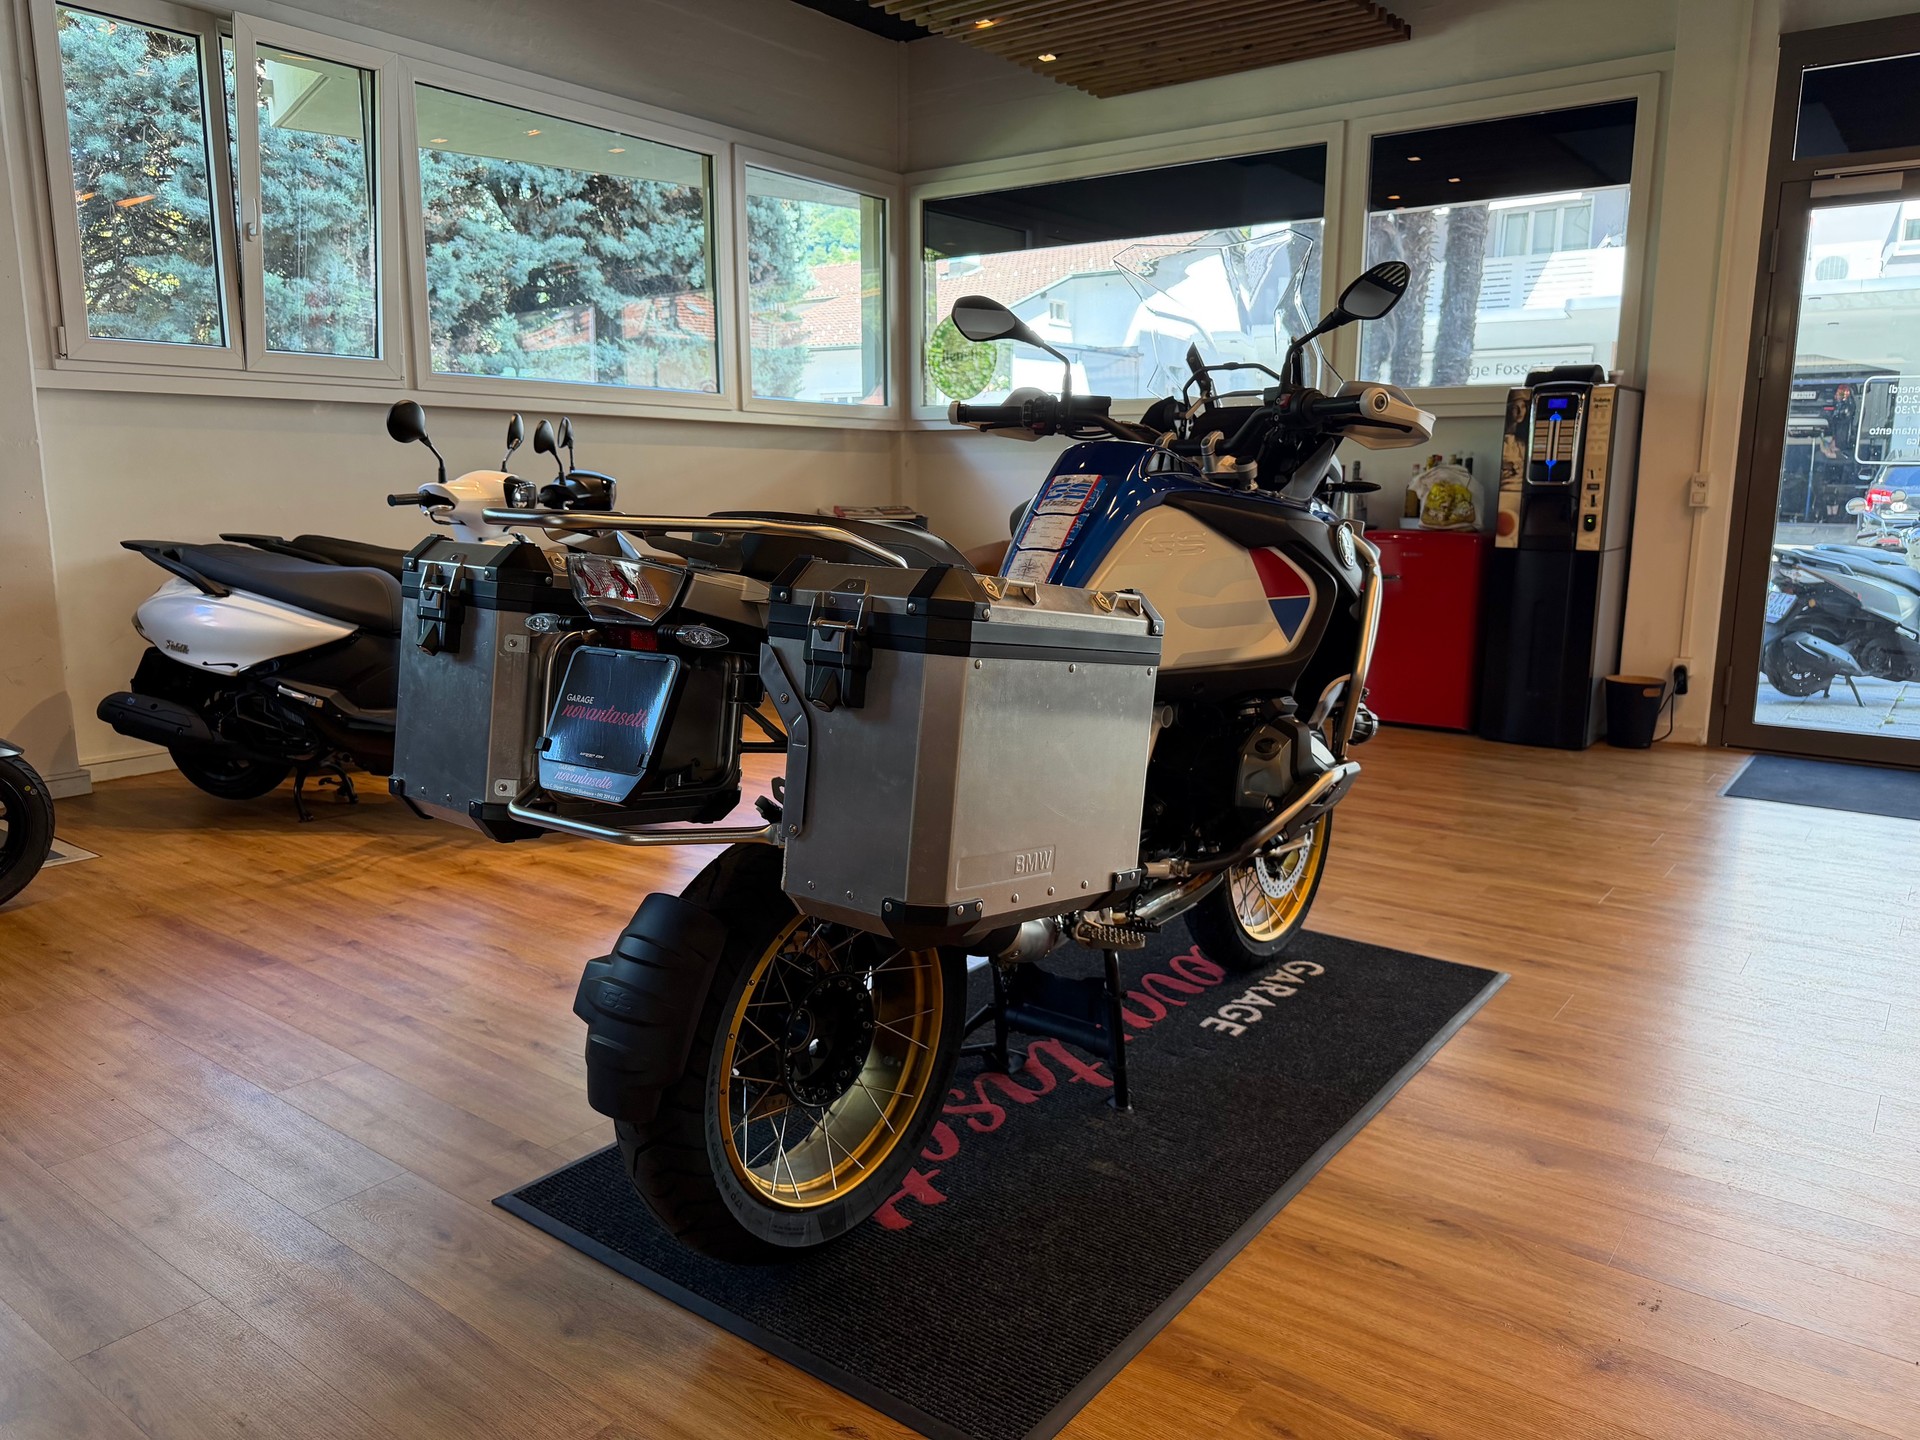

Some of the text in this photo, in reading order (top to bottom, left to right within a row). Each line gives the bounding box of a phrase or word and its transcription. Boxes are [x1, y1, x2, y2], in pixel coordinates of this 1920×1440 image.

[1143, 530, 1208, 558] GS
[567, 693, 595, 704] GARAGE
[562, 704, 649, 728] novantasette
[554, 771, 613, 789] novantasette
[1014, 849, 1052, 874] BMW
[1200, 960, 1325, 1038] GARAGE
